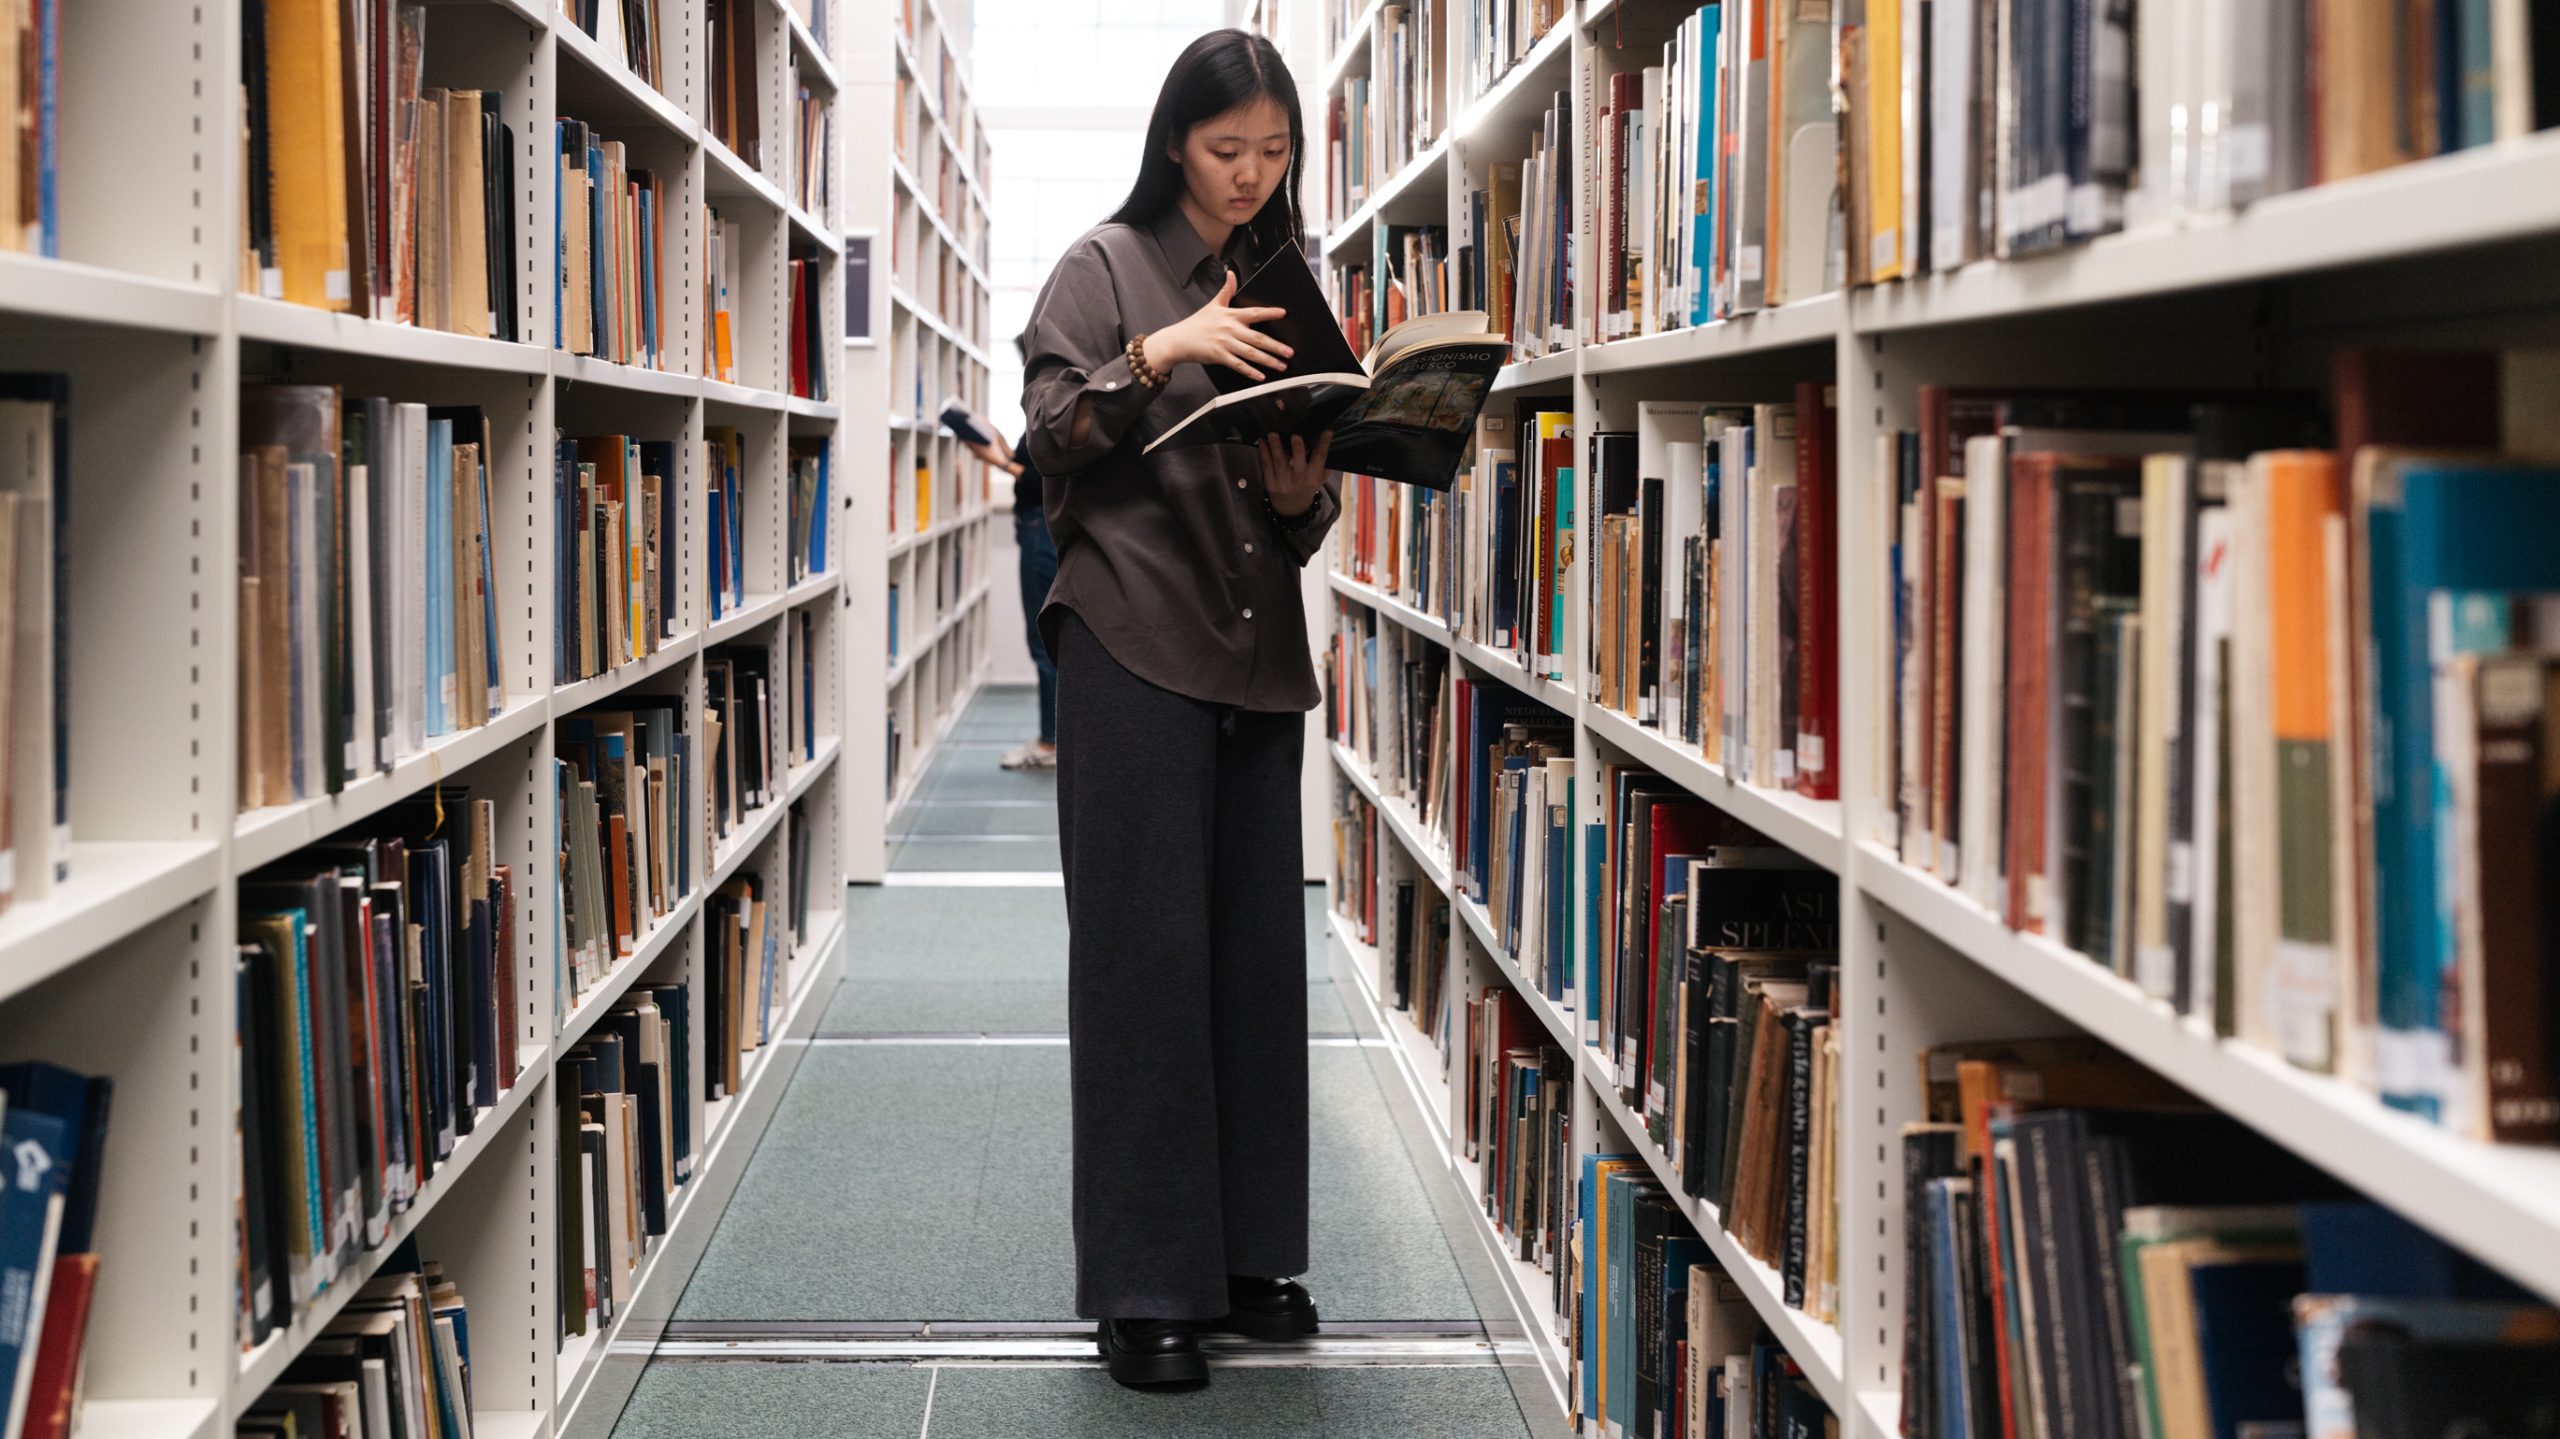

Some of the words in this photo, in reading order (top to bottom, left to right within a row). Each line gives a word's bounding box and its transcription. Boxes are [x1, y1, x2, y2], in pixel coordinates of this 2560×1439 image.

[1583, 61, 1592, 160] PINAKOTHEK
[1583, 163, 1592, 206] NEUE
[1583, 213, 1592, 236] DIE
[1648, 1296, 1657, 1355] paintings
[1690, 1346, 1699, 1422] pioneers
